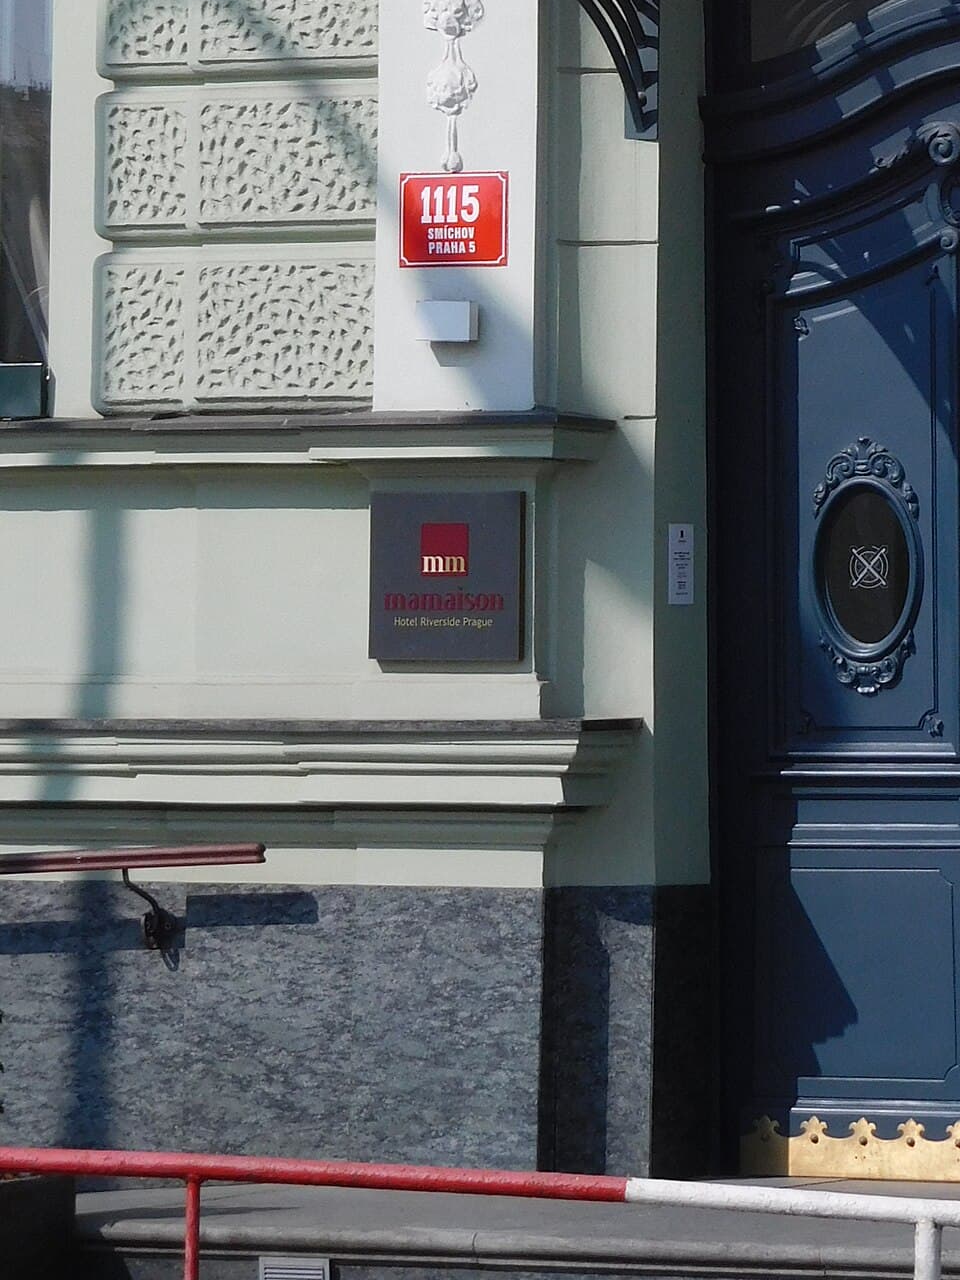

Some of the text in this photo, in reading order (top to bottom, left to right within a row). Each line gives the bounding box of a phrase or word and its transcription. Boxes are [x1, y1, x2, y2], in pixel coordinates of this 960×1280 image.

[421, 184, 480, 224] 1115
[427, 225, 475, 240] SMÍCHOV
[428, 241, 476, 254] PRAHA 5
[422, 555, 466, 573] mm
[384, 586, 504, 611] mamaison
[394, 616, 493, 629] Hotel Riverside Prague
